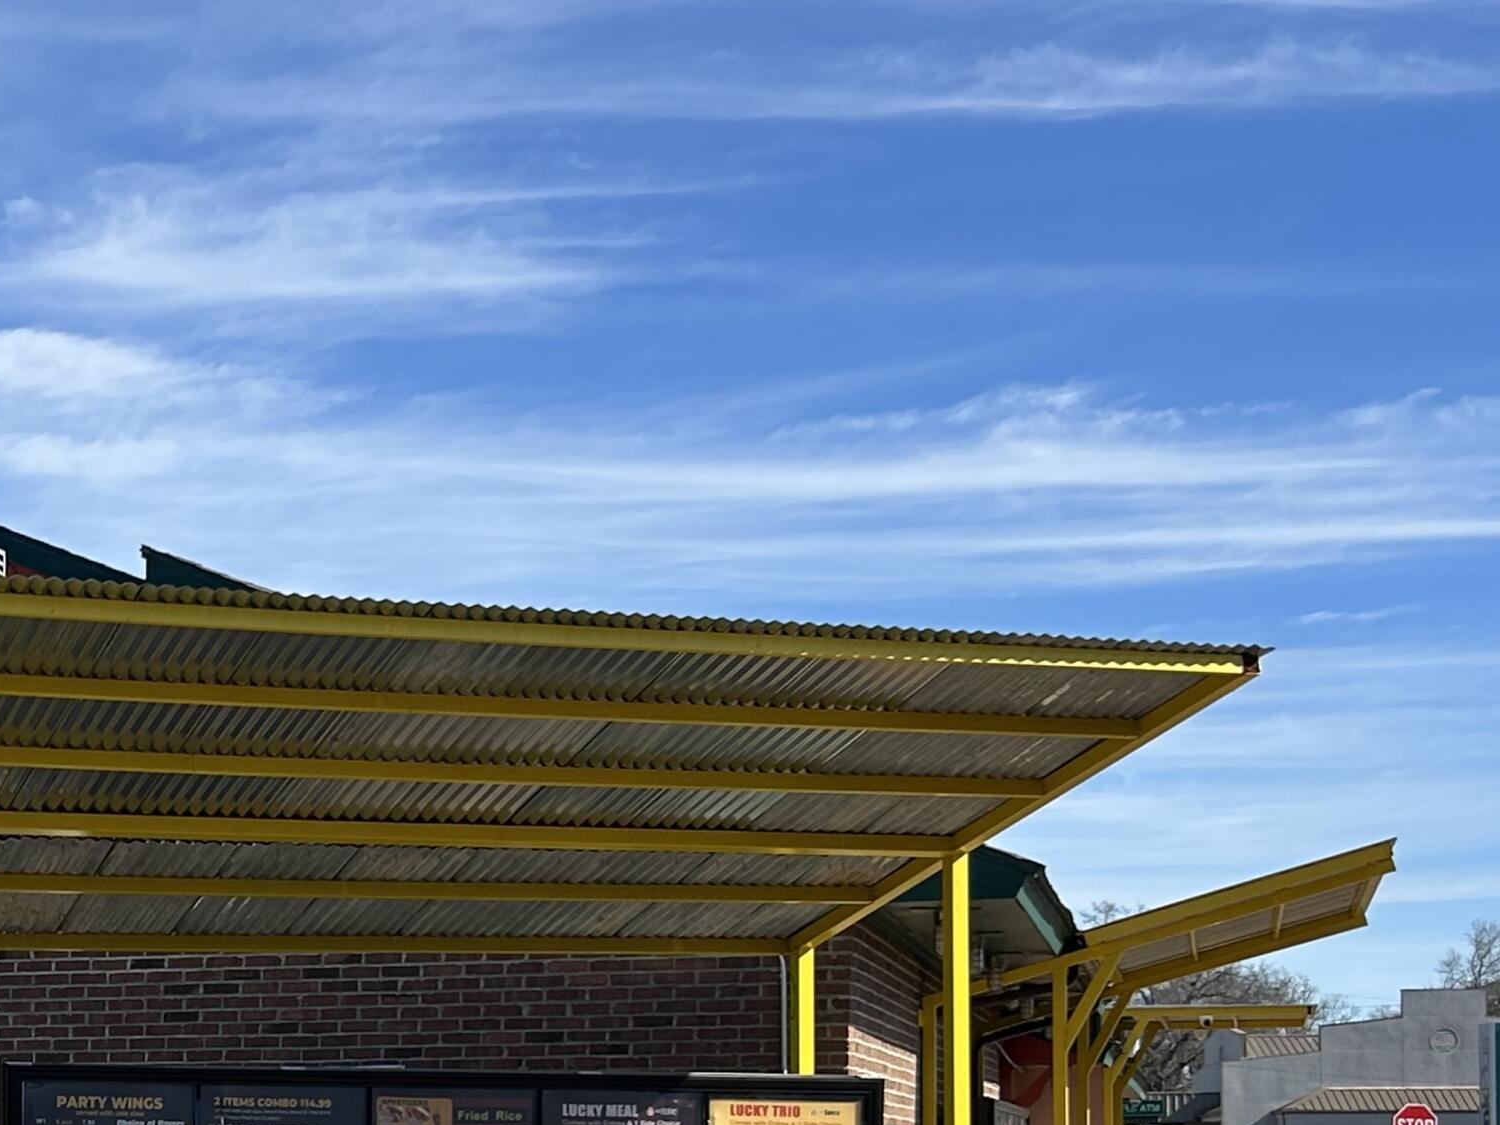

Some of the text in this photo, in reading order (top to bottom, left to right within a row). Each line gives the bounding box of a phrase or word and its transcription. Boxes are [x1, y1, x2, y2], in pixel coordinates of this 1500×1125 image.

[56, 1096, 164, 1110] PARTY WINGS
[213, 1096, 221, 1107] 2
[222, 1096, 256, 1107] ITEMS
[257, 1097, 298, 1108] COMBO
[457, 1110, 523, 1122] Fried Rice
[561, 1103, 640, 1119] LUCKY MEAL
[730, 1103, 801, 1118] LUCKY TRIO
